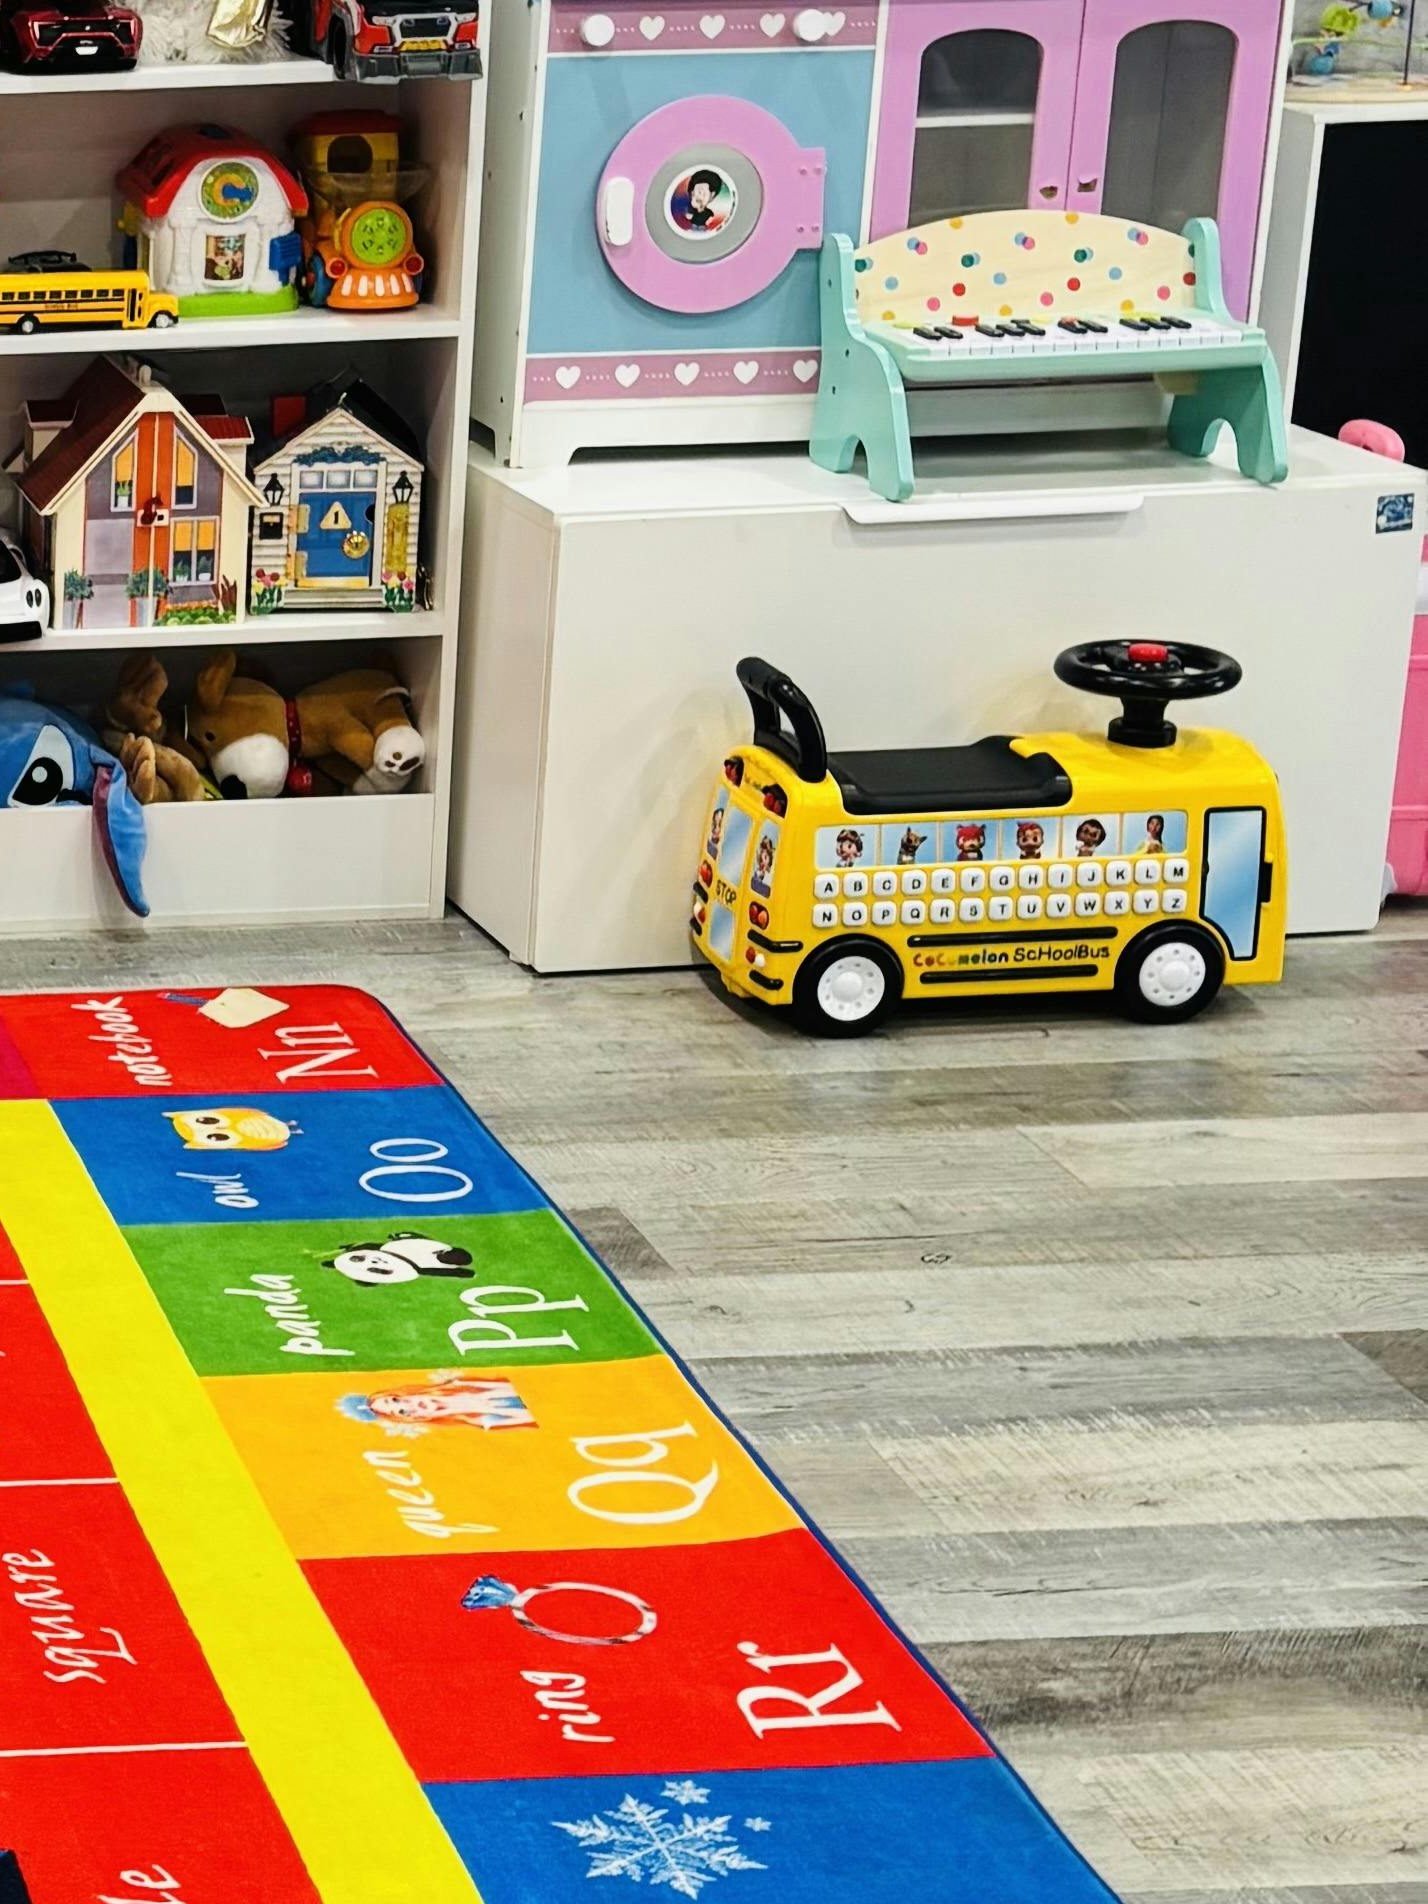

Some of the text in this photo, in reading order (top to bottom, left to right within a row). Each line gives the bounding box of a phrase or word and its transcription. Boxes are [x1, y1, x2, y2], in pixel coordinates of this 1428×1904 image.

[716, 879, 737, 904] STOP
[69, 995, 175, 1087] notebook
[257, 1022, 378, 1084] Nn
[178, 1171, 260, 1209] owl
[358, 1137, 474, 1203] Oo
[223, 1273, 355, 1356] panda
[447, 1285, 590, 1356] Pp
[362, 1450, 498, 1539] queen
[566, 1418, 720, 1526] Qq
[1, 1548, 137, 1684] square
[519, 1670, 615, 1743] ring
[736, 1641, 902, 1739] Rr
